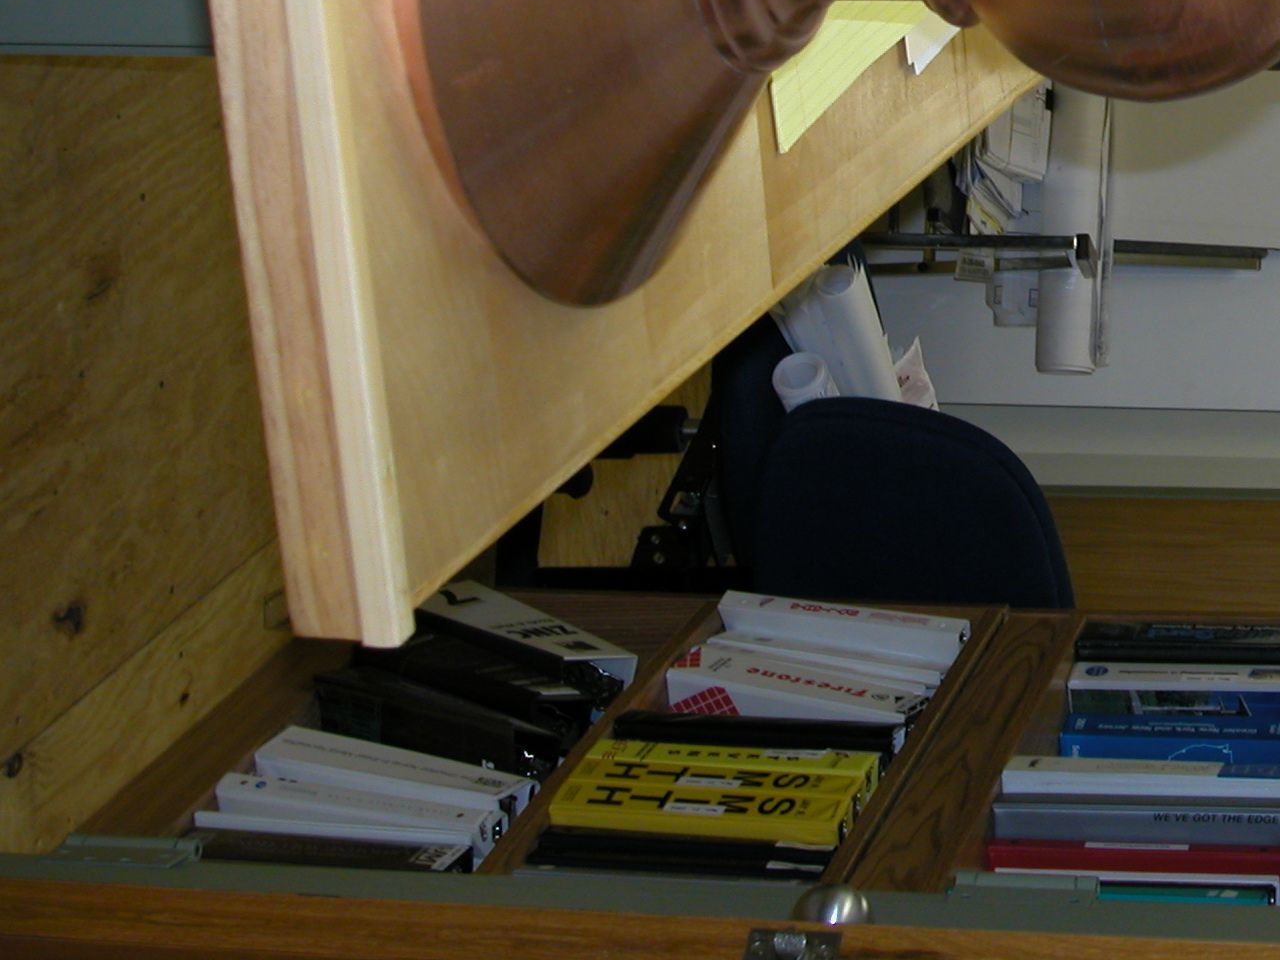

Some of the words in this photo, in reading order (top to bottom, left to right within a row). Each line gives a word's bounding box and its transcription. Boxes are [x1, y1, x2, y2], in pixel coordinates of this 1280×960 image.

[746, 666, 868, 698] Firestone
[604, 761, 810, 789] SMITH
[587, 784, 796, 816] SMITH
[1192, 813, 1216, 823] GOT
[1221, 814, 1243, 824] THE
[1247, 814, 1279, 825] EDGE
